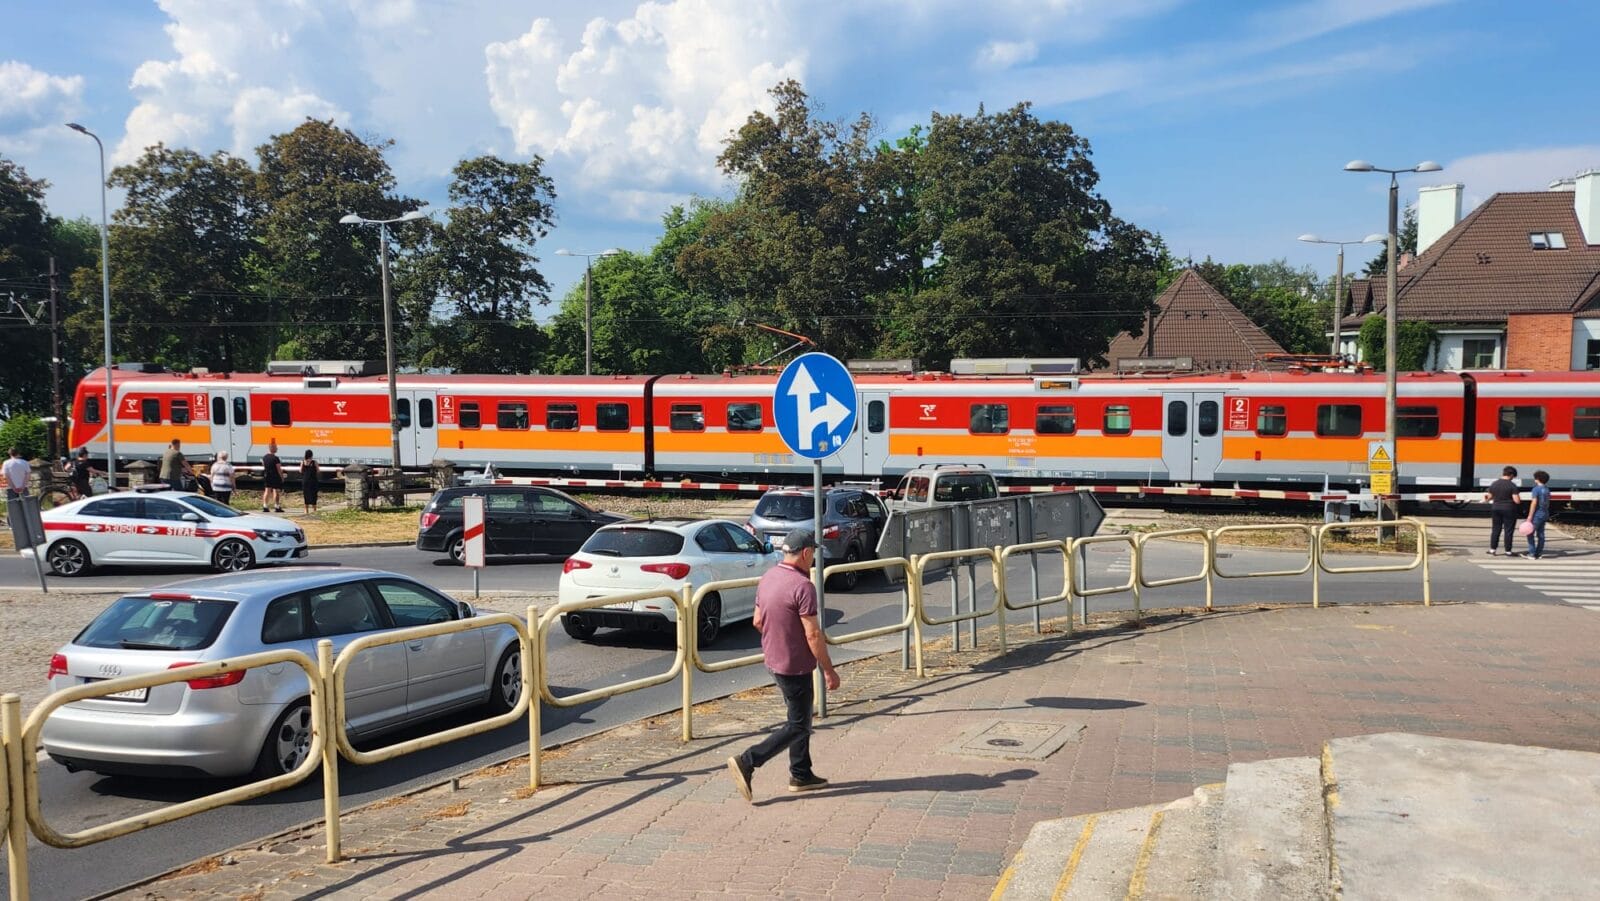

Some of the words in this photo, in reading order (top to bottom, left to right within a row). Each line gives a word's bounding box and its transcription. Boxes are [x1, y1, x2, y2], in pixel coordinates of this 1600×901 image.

[196, 395, 203, 405] 2
[443, 397, 450, 408] 2
[1236, 399, 1244, 411] 2
